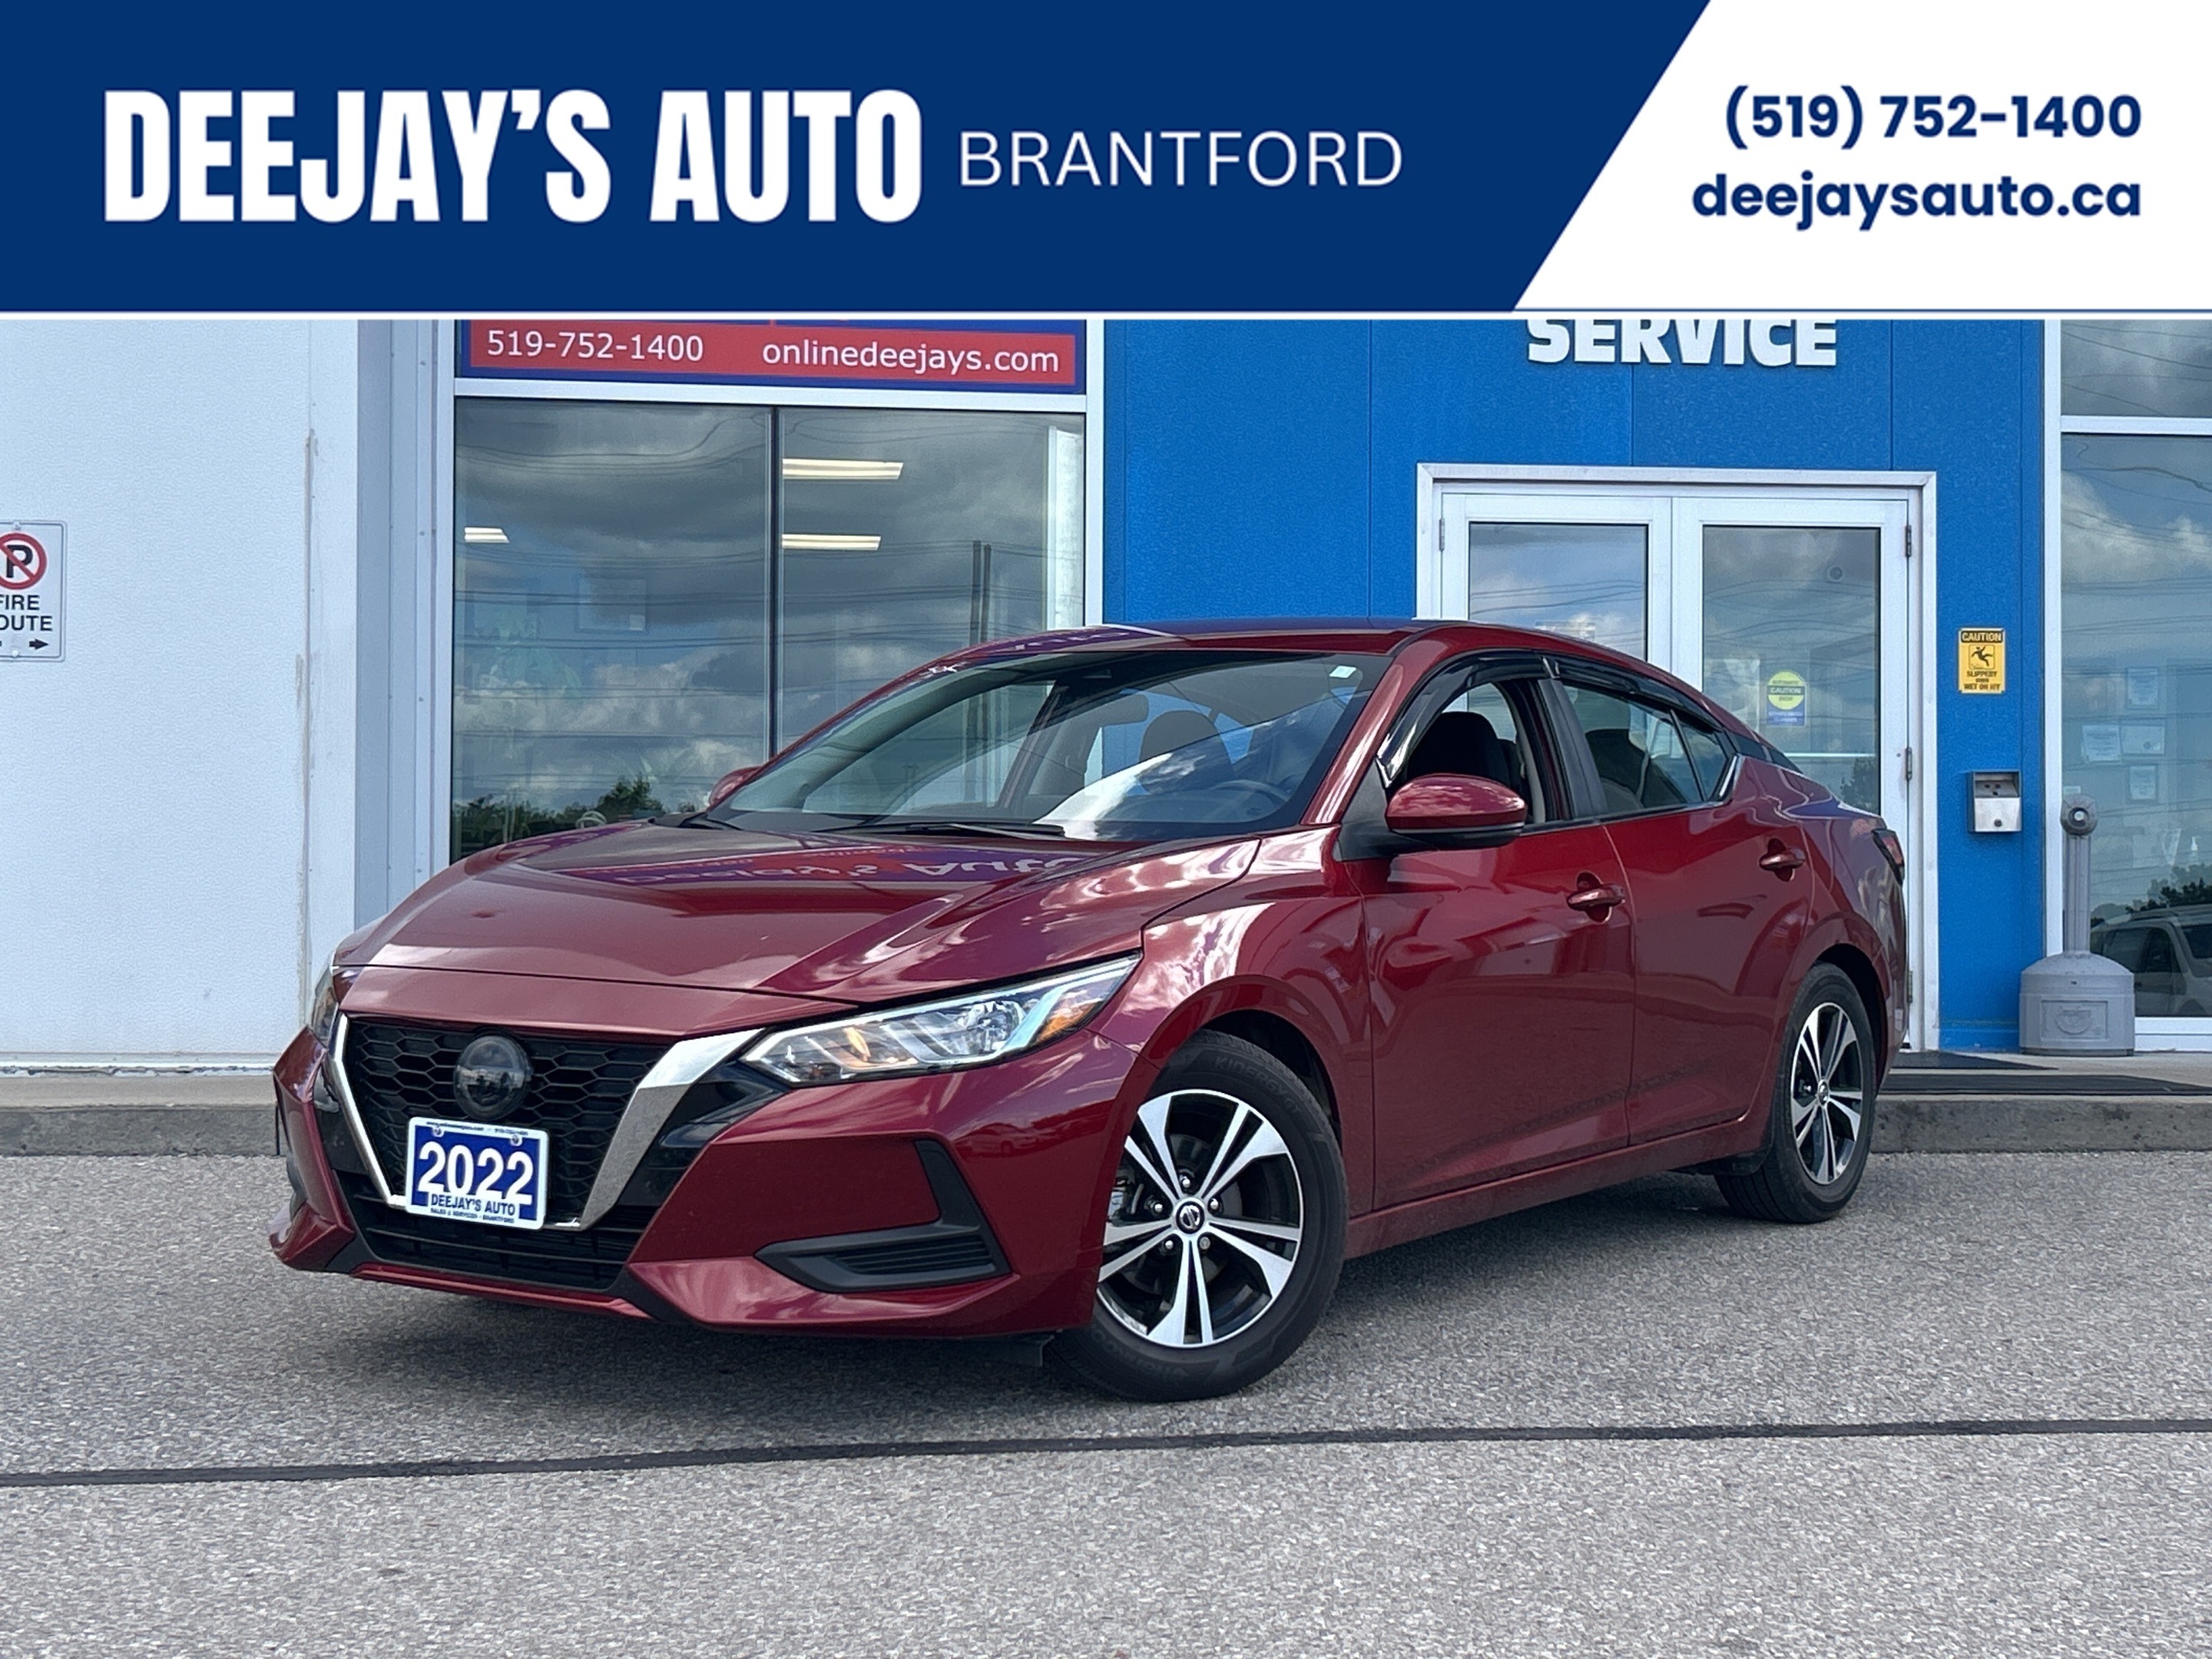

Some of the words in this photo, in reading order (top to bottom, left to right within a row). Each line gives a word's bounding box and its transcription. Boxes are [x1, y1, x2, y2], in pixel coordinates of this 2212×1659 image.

[488, 329, 703, 361] 519-752-1400
[763, 339, 1058, 376] onlinedeejays.com
[1527, 320, 1836, 366] SERVICE
[0, 594, 40, 611] IRE
[1962, 632, 2002, 641] CAUTION
[418, 1141, 534, 1206] 2022
[431, 1194, 482, 1212] DEEJAY'S
[485, 1201, 515, 1216] AUTO
